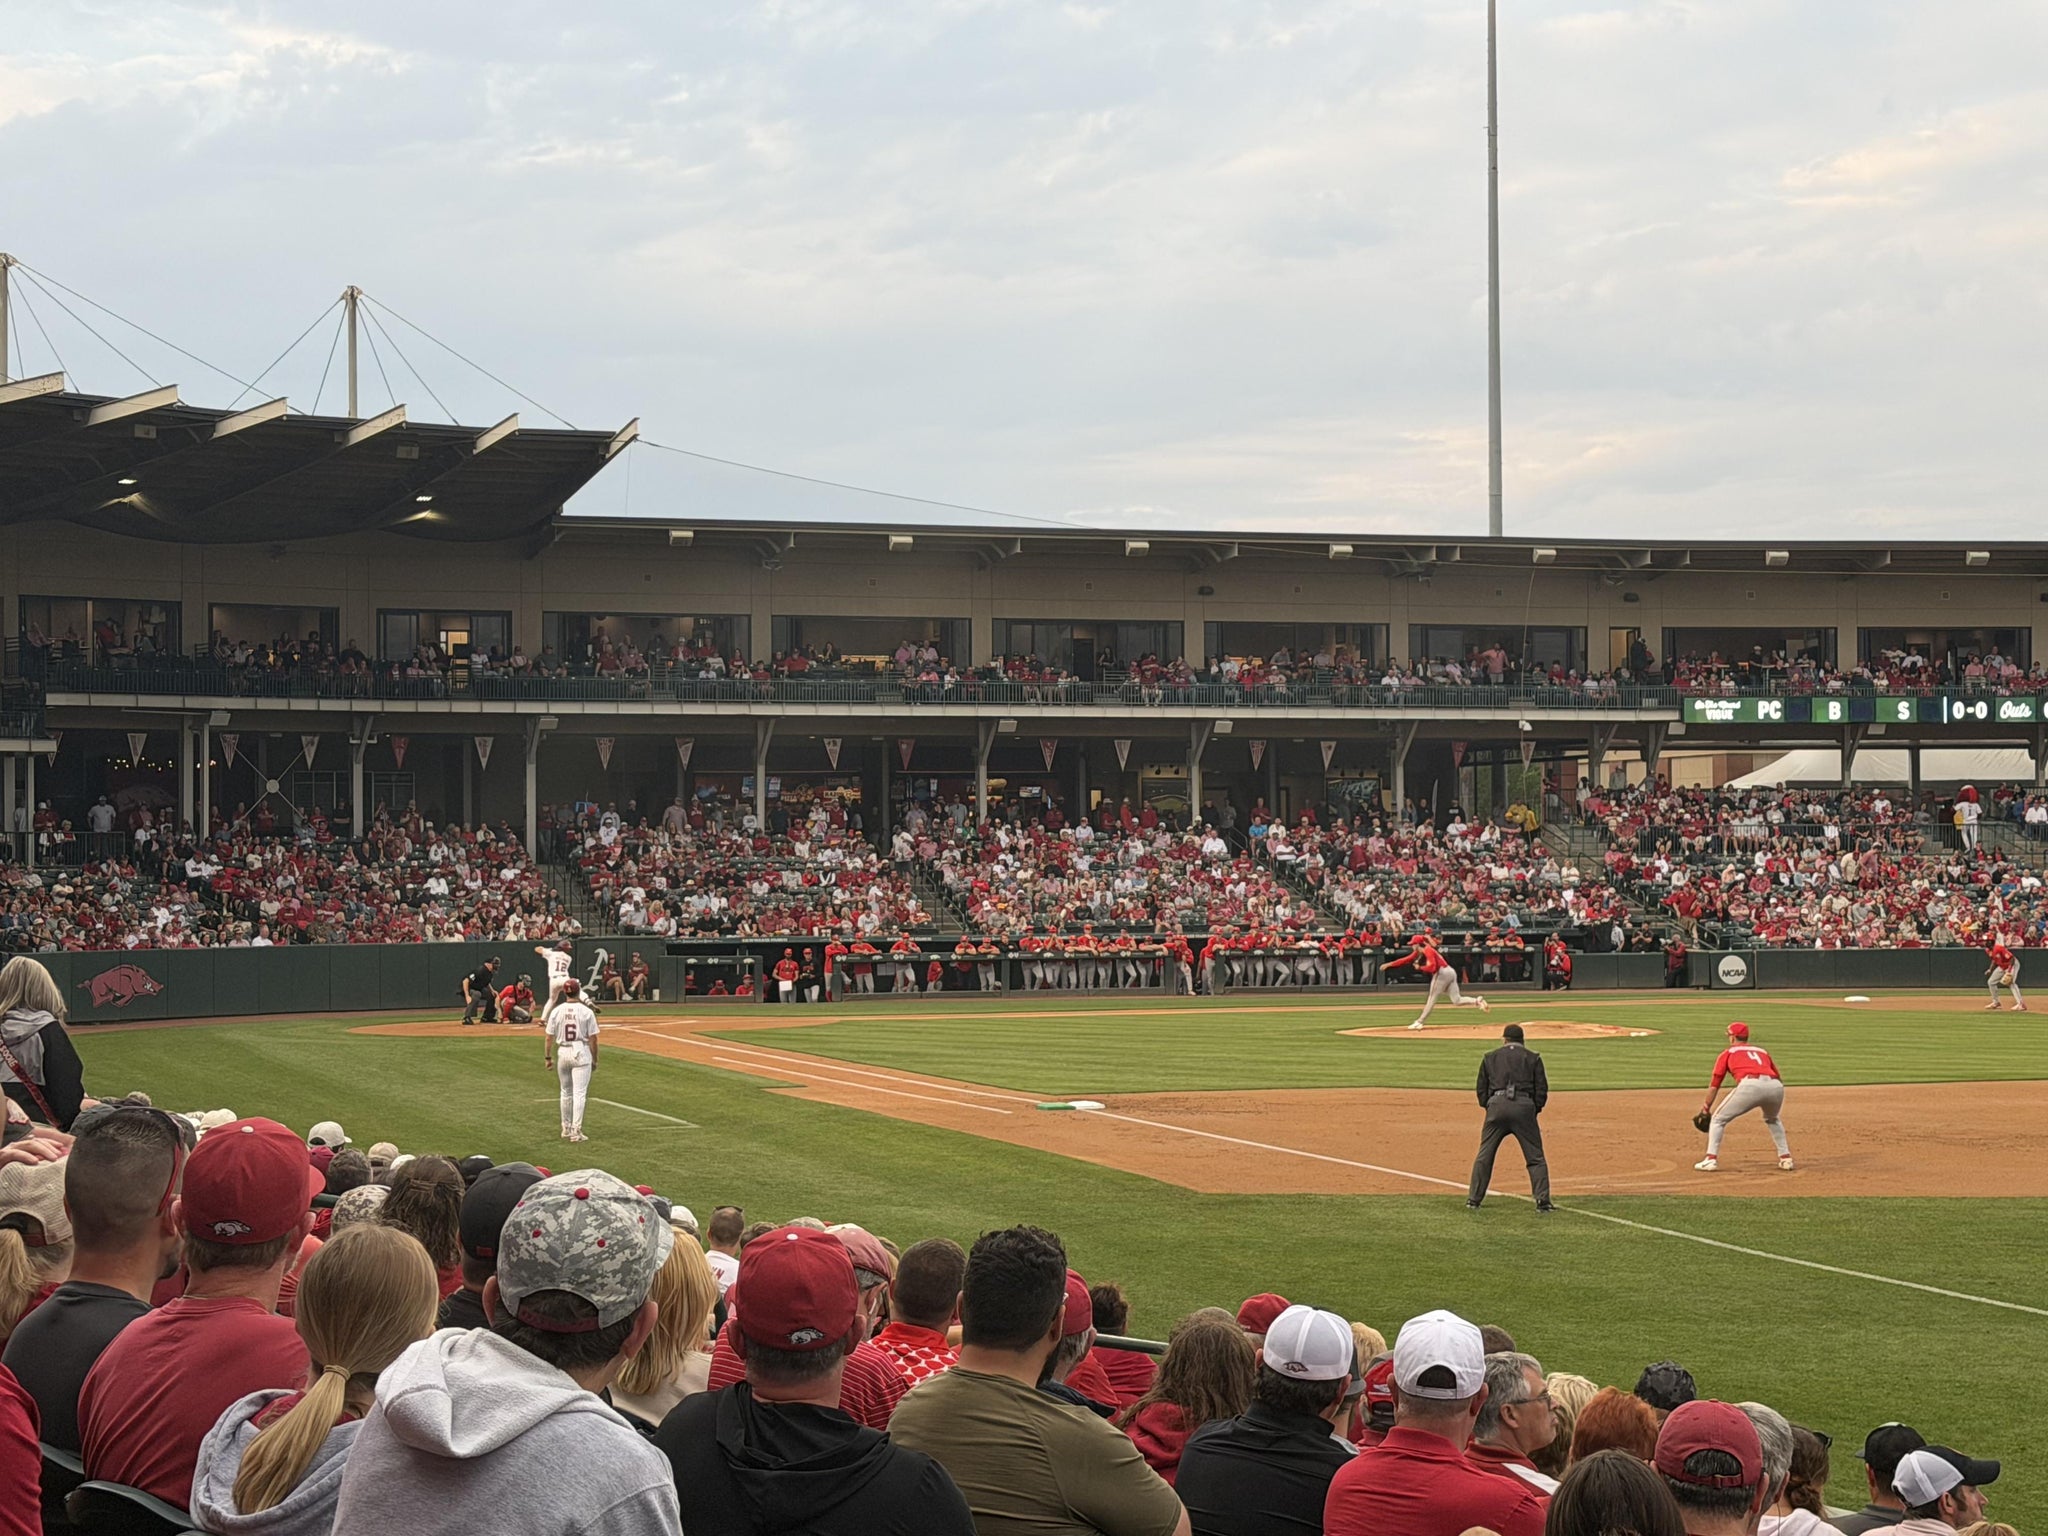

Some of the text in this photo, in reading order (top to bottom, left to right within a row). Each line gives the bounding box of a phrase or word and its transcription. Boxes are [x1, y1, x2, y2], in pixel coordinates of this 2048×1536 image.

[1757, 701, 1782, 720] PC
[1828, 701, 1842, 720] B
[1897, 700, 1911, 720] S
[1952, 701, 1988, 720] 0-0
[1999, 700, 2033, 720] Outs
[555, 961, 568, 972] 12
[1721, 968, 1746, 978] NCAA
[564, 1023, 577, 1041] 6
[1746, 1050, 1763, 1066] 4
